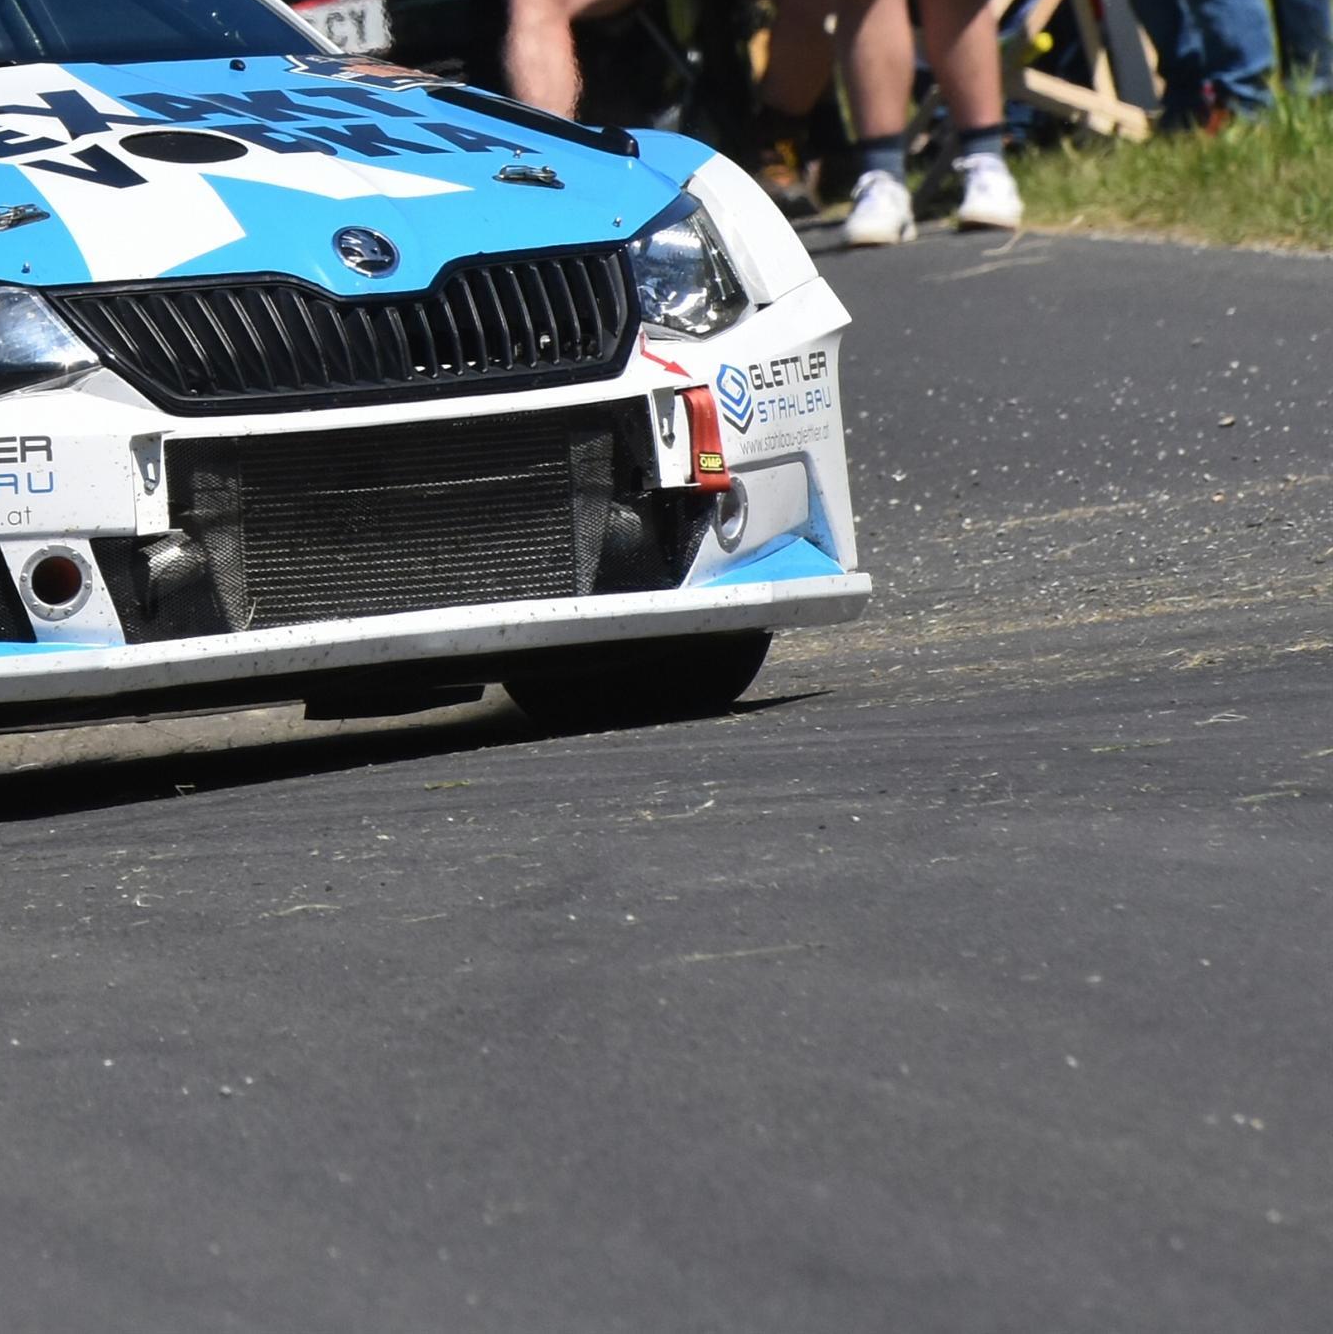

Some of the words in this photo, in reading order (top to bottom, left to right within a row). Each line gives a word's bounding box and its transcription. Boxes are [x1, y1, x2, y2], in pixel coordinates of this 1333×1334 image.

[748, 351, 829, 391] GLETTLER
[757, 386, 832, 424] STAHLBAU
[699, 456, 723, 469] OMP
